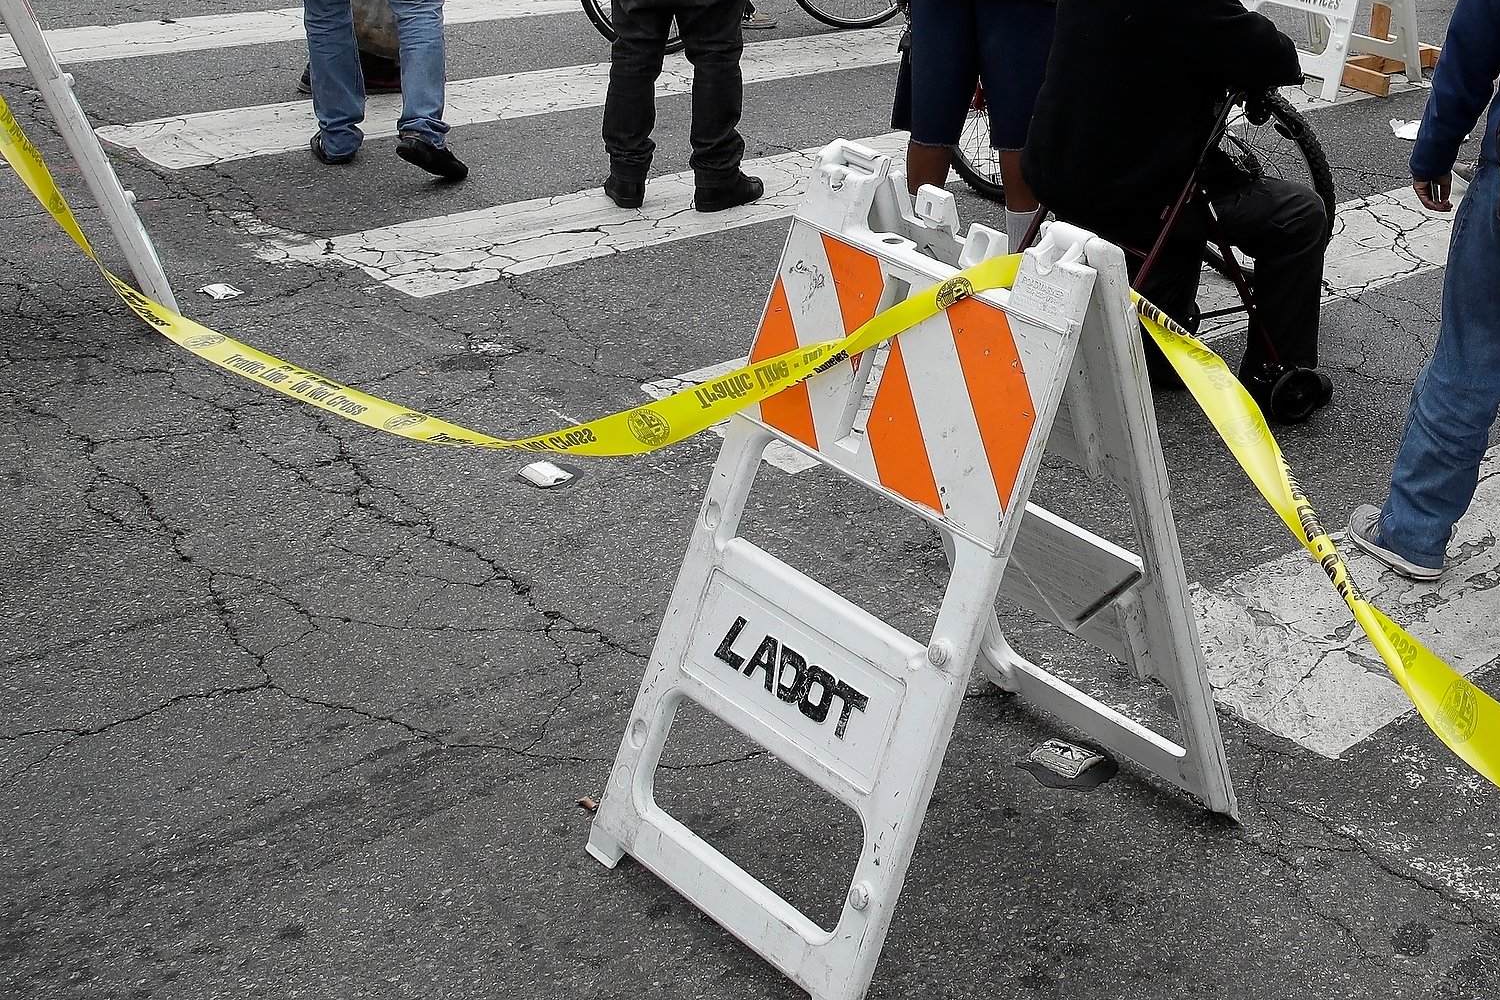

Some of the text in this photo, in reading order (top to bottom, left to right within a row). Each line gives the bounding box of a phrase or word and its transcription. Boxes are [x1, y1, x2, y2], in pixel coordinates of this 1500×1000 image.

[222, 353, 367, 416] Traffic Line Do Not Cross
[714, 615, 870, 740] LADOT
